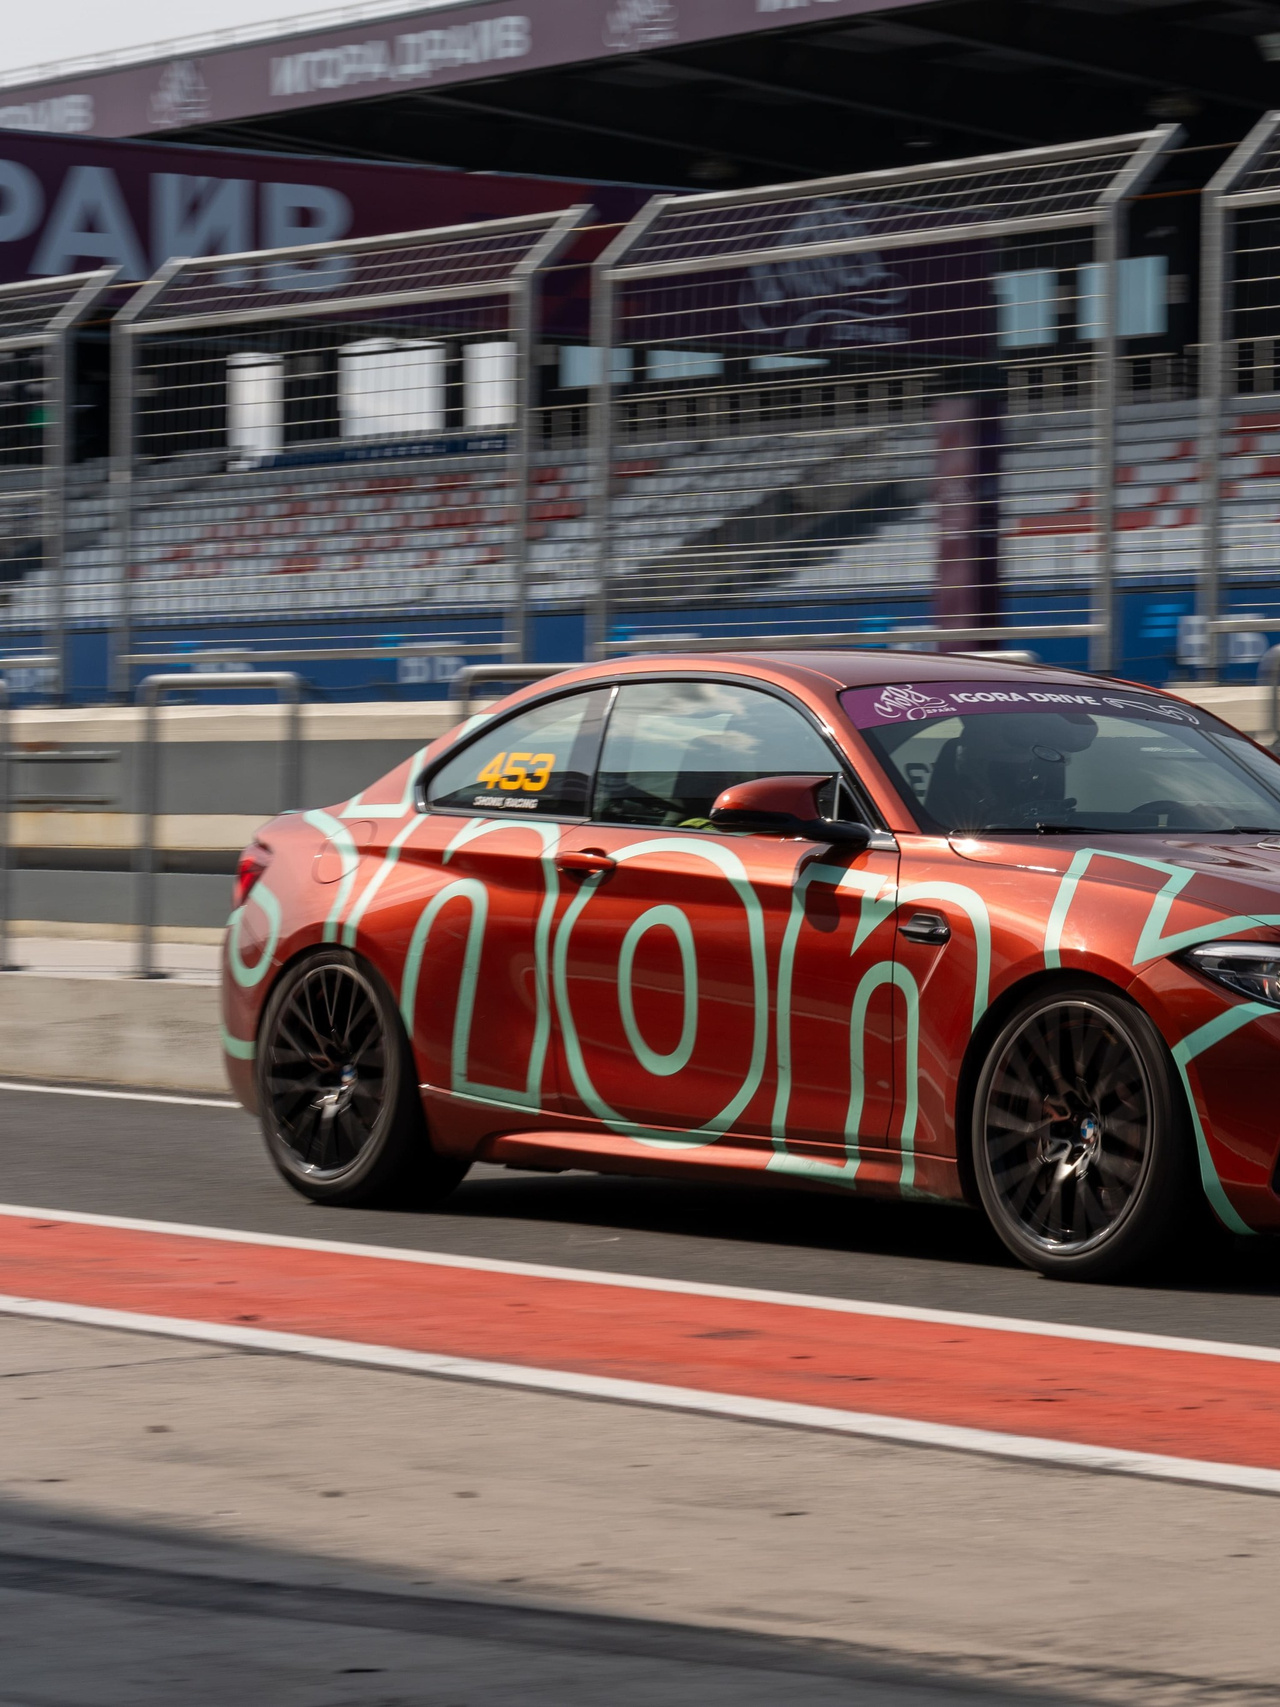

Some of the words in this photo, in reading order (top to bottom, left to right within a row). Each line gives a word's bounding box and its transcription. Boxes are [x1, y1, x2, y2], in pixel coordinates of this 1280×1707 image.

[948, 692, 1029, 703] IGORA
[1027, 692, 1102, 706] DRIVE
[476, 752, 556, 791] 453
